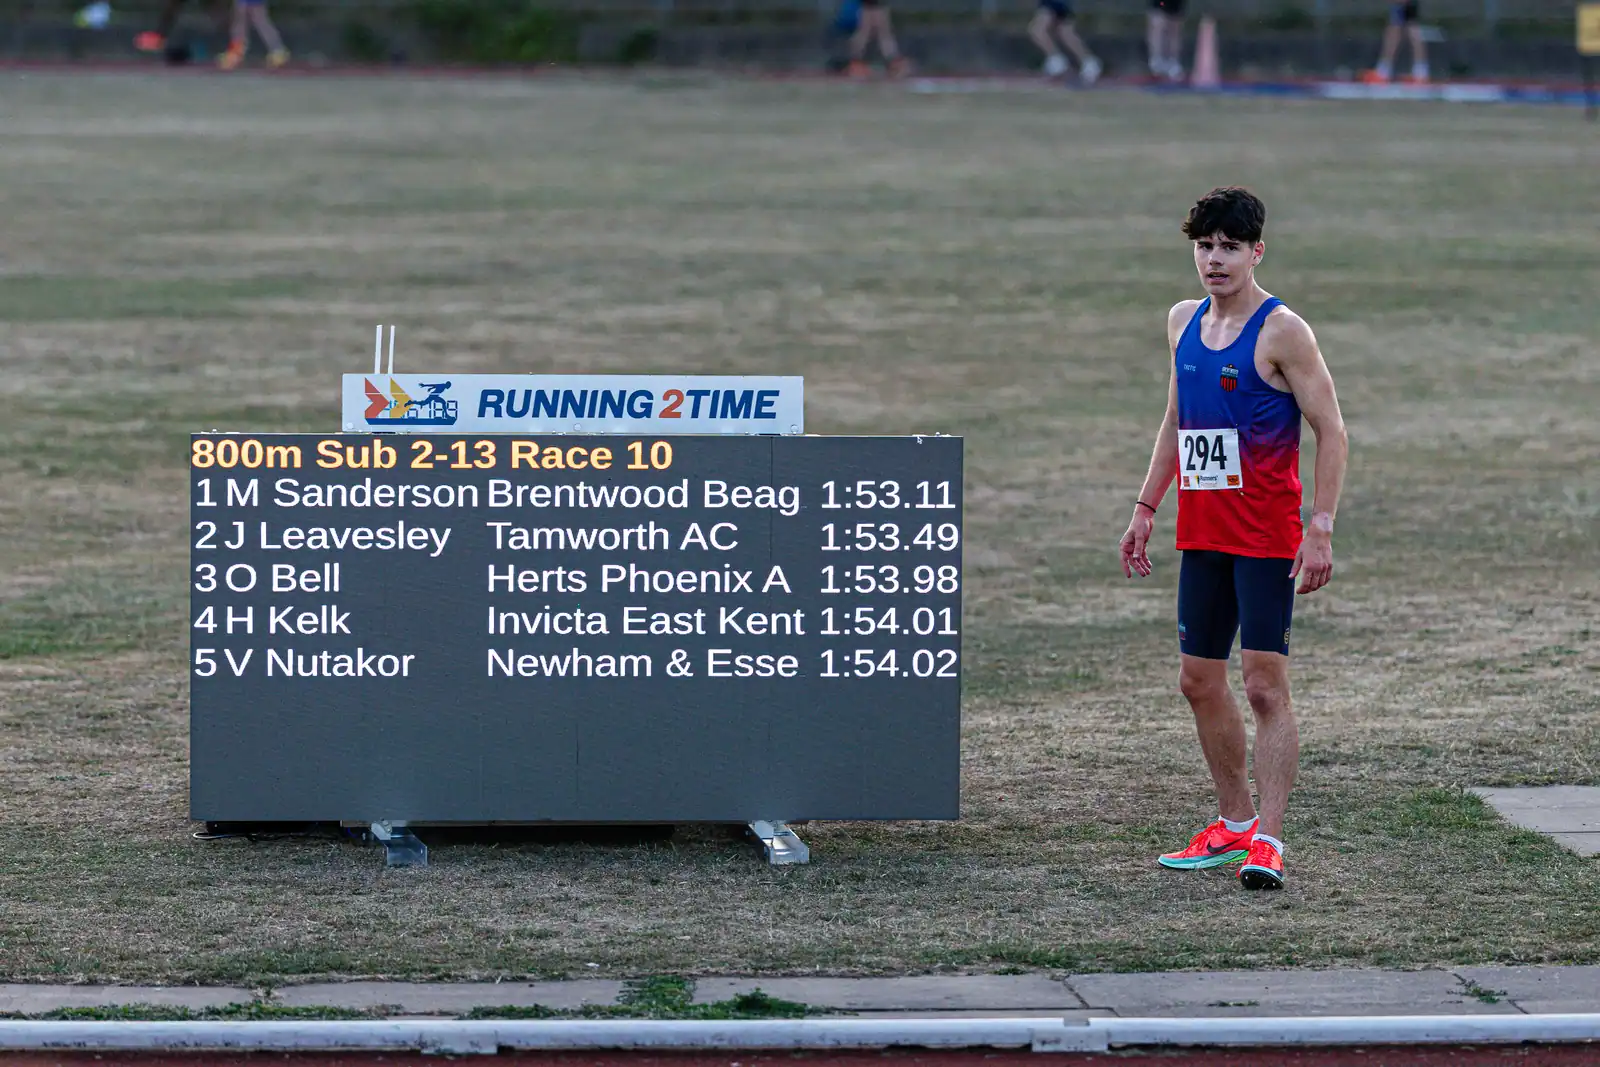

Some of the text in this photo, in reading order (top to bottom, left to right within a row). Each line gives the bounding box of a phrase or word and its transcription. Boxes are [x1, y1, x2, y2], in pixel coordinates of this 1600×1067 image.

[191, 439, 673, 470] 800m Sub 2-13 Race 10
[1184, 434, 1228, 471] 294
[196, 478, 955, 516] 1 M Sanderson Brentwood Beag 1:53.11
[195, 521, 959, 557] 2 J Leavesley Tamworth AC 1:53.49
[195, 563, 959, 594] 3 O Bell Herts Phoenix A 1:53.98
[194, 605, 957, 636] 4 H Kelk Invicta East Kent 1:54.01
[194, 648, 958, 678] 5 V Nutakor Newham & Esse 1:54.02
